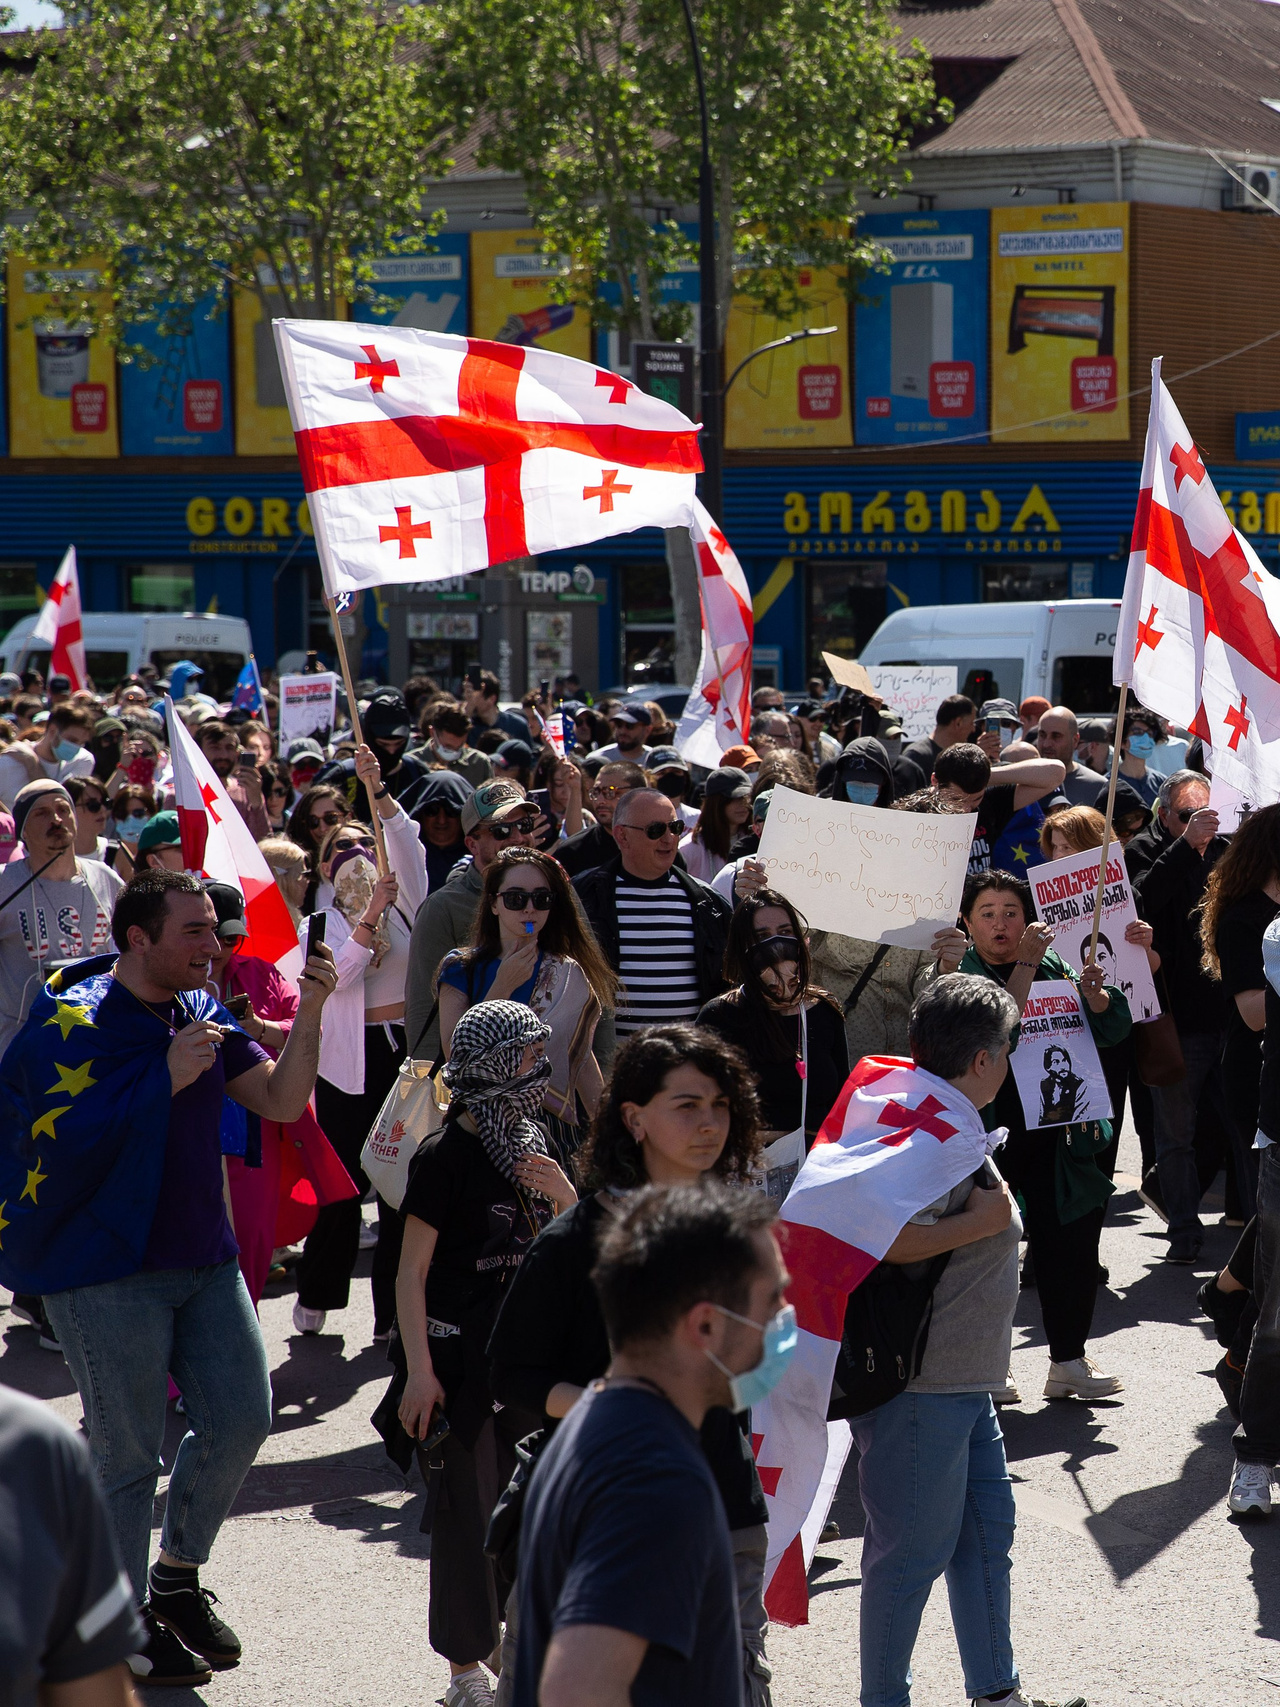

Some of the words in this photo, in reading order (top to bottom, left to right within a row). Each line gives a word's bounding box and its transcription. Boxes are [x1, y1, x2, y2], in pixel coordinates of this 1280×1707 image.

[645, 362, 685, 373] SQUARE
[650, 351, 680, 361] TOWN
[186, 496, 314, 536] GORG
[783, 490, 1002, 534] გორგია
[189, 541, 278, 553] CONSTRUCTION
[788, 539, 920, 553] მშენებლობა
[965, 539, 1062, 553] რემონტი
[175, 633, 220, 645] POLICE
[1036, 859, 1124, 905] თავისუფლება
[1041, 898, 1080, 926] ვეფხია
[18, 905, 109, 960] USA
[1022, 995, 1080, 1018] ისუფლება
